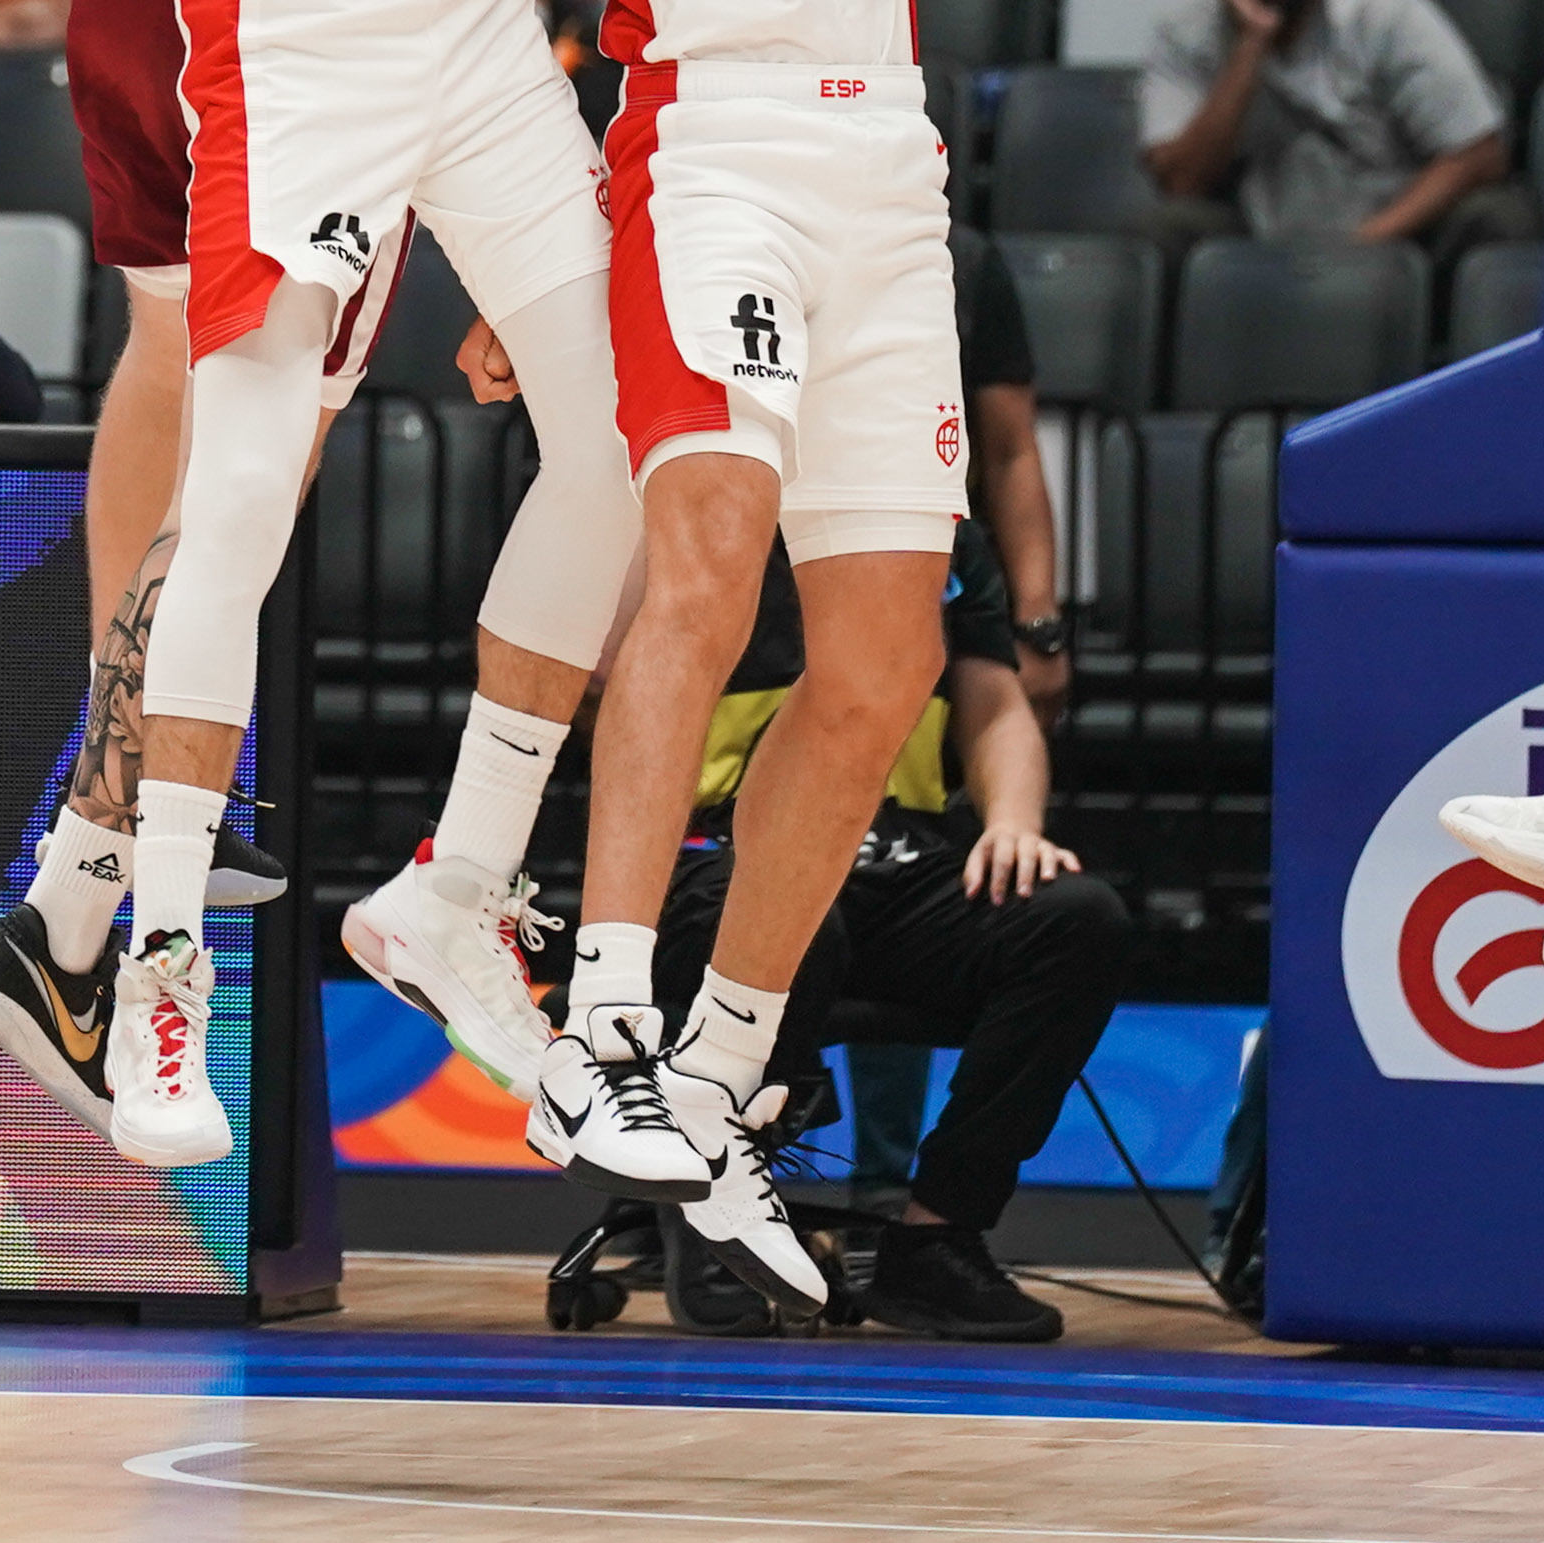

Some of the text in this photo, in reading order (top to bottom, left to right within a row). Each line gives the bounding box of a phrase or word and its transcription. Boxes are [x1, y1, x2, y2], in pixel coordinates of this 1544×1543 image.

[819, 79, 867, 99] ESP
[312, 243, 369, 275] networ
[733, 362, 801, 387] network
[77, 859, 127, 885] PEAK
